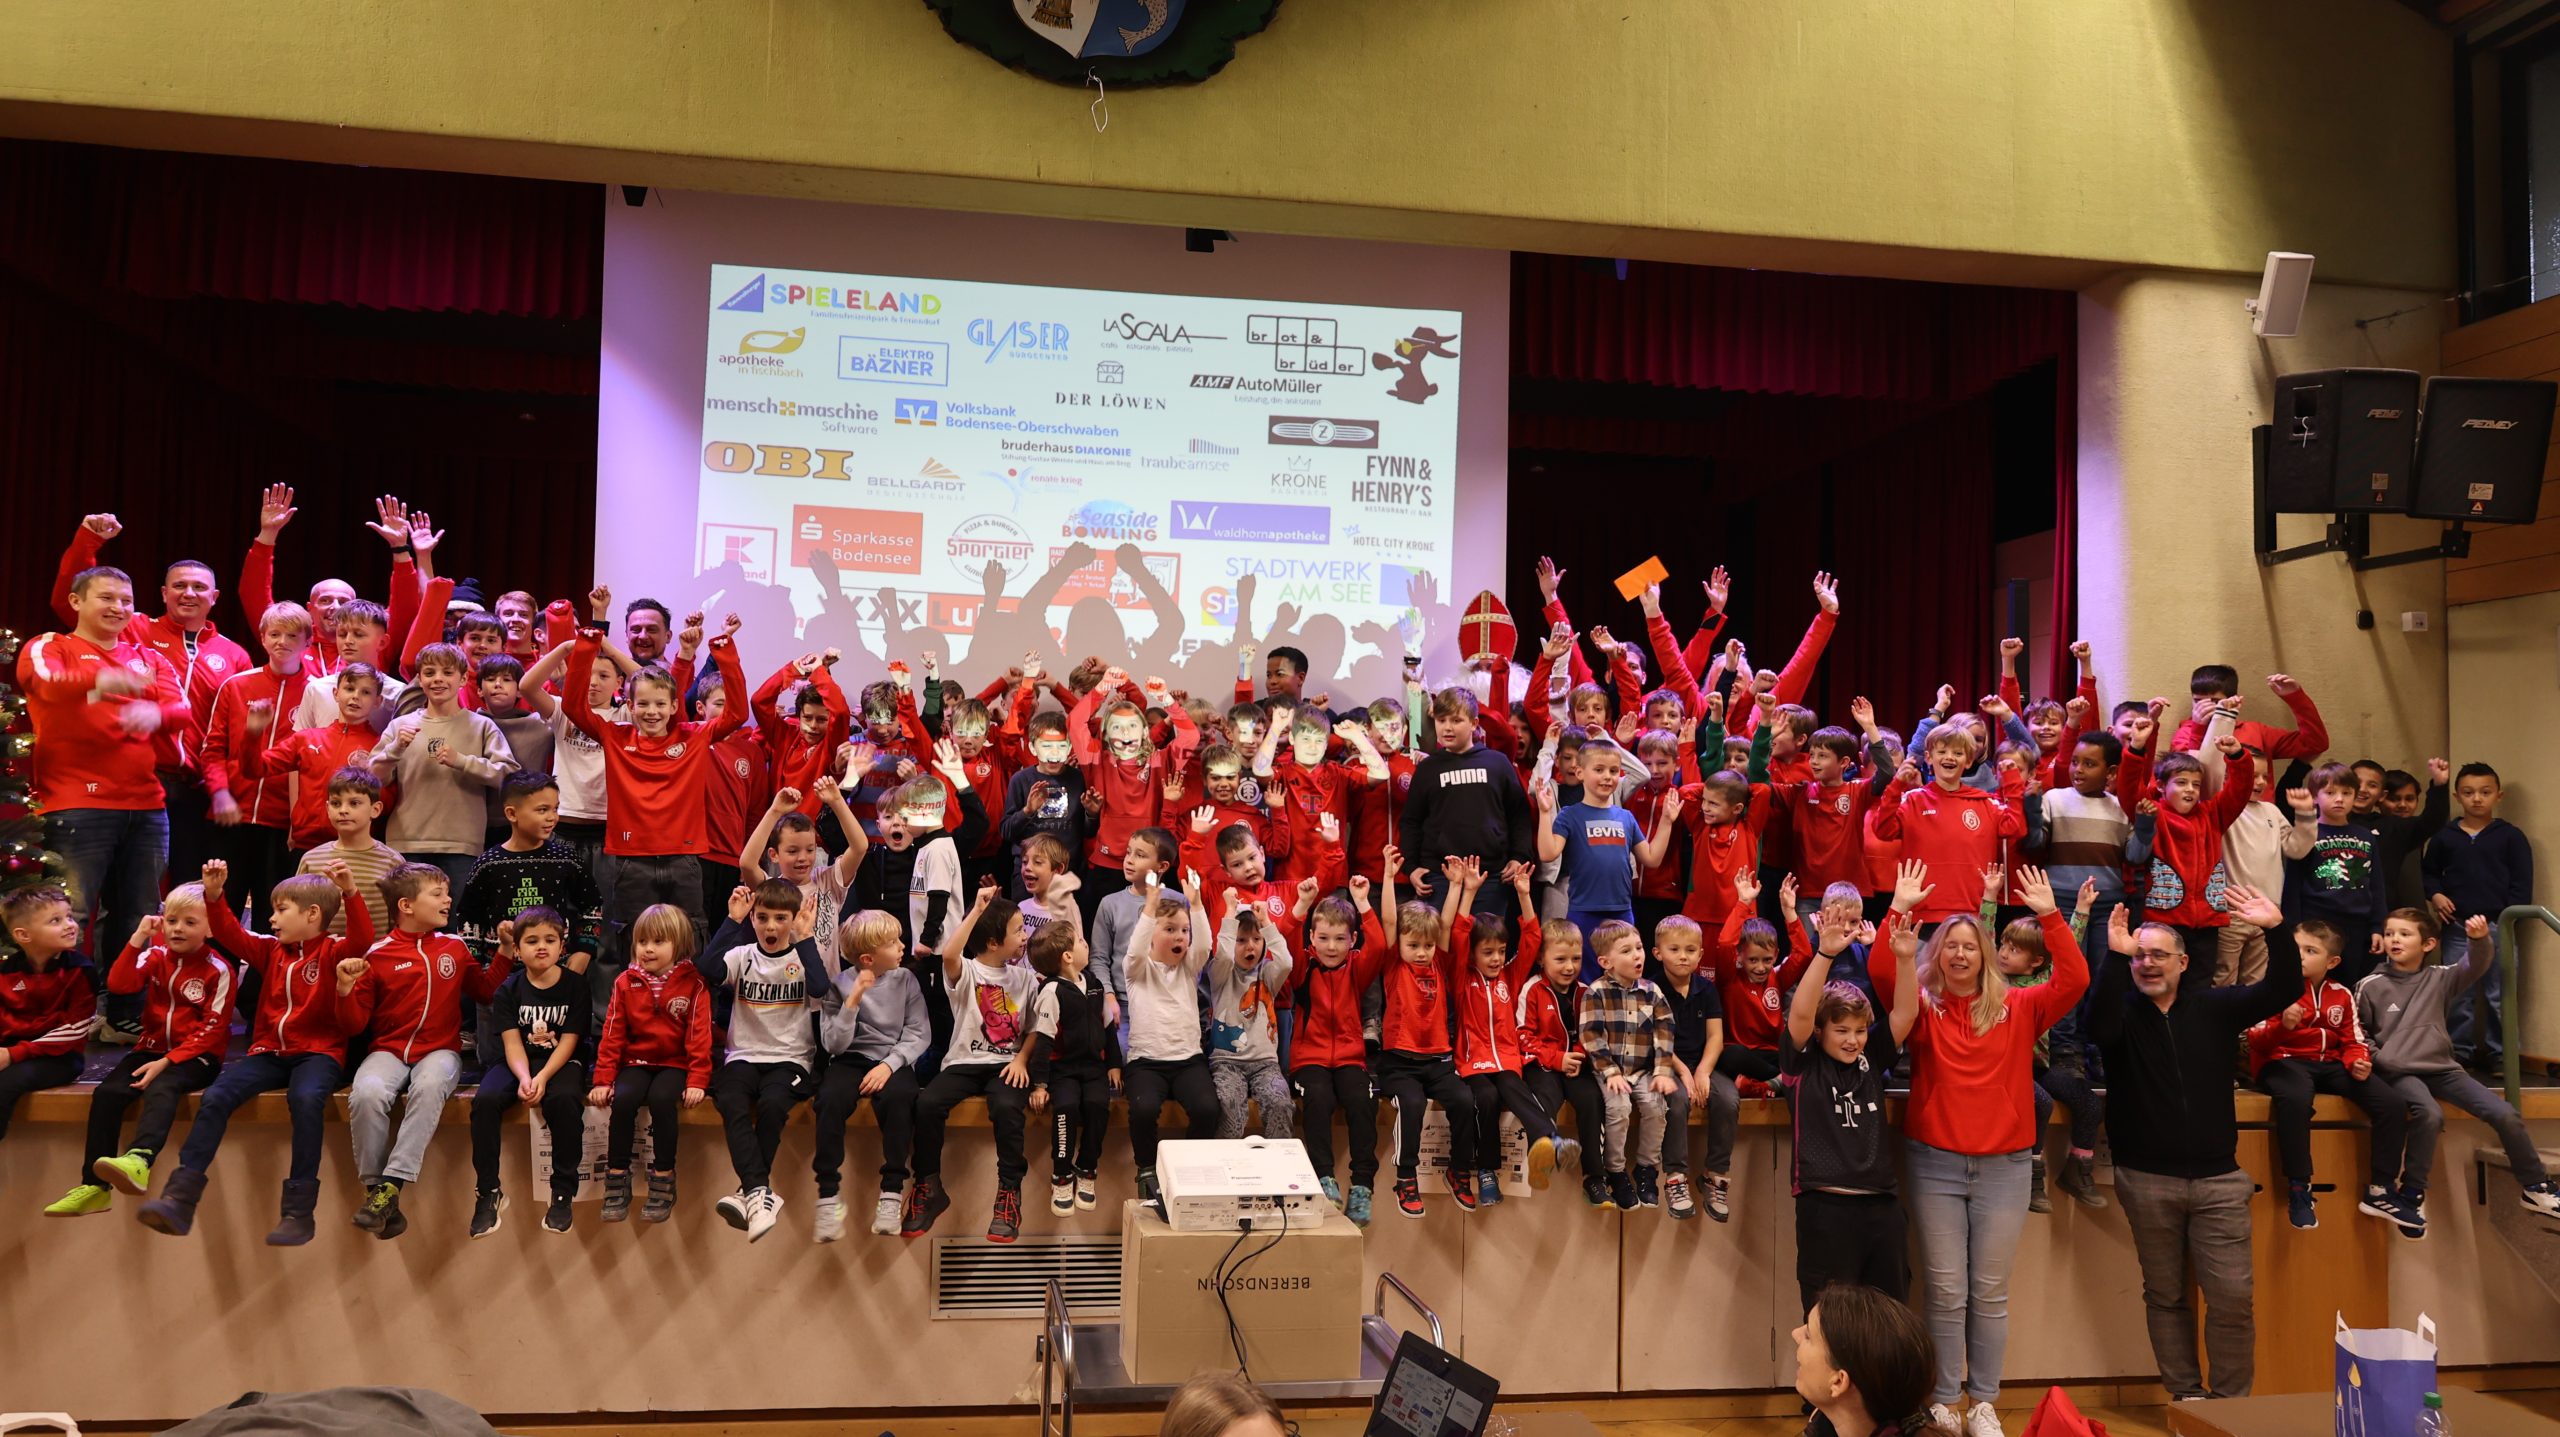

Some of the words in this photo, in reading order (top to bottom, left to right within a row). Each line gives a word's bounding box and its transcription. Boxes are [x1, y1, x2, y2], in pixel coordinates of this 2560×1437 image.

[770, 283, 942, 315] SPIELELAND
[967, 318, 1069, 364] GLASER
[718, 354, 784, 367] apotheke
[879, 347, 934, 360] ELEKTRO
[750, 366, 804, 378] fischbach
[851, 354, 933, 377] BÄZNER
[1193, 376, 1233, 389] AMF
[1235, 376, 1322, 394] AutoMüller
[946, 402, 1016, 417] Volksbank
[1056, 392, 1092, 406] DER
[1101, 393, 1167, 410] LÖWEN
[821, 420, 878, 435] Software
[945, 416, 1119, 437] Bodensee-Oberschwaben
[2461, 419, 2519, 430] PEAVEY
[1001, 439, 1132, 457] bruderhausDIAKONIE
[704, 440, 854, 481] OBI
[1366, 455, 1416, 479] FYNN
[1418, 459, 1432, 481] &
[867, 476, 967, 492] BELLGARDT
[1271, 473, 1327, 489] KRONE
[1077, 508, 1159, 529] Seaside
[832, 529, 914, 547] Sparkasse
[1062, 525, 1158, 541] BOWLING
[1213, 528, 1327, 542] waldhornapotheke
[1353, 536, 1380, 547] HOTEL
[1383, 538, 1403, 549] CITY
[1406, 539, 1435, 552] KRONE
[832, 548, 912, 565] Bodensee
[1225, 556, 1373, 582] STADTWERK
[1278, 583, 1322, 602] AM
[1330, 584, 1373, 603] SEE
[1439, 768, 1488, 788] PUMA
[86, 783, 98, 792] YF
[622, 831, 632, 841] IF
[2314, 837, 2372, 853] ROARSOME
[394, 961, 413, 971] JAKO
[744, 958, 753, 976] 7
[738, 978, 805, 1001] DEUTSCHLAND
[518, 1004, 569, 1027] STAYING
[1057, 1113, 1067, 1158] RUNNING
[1197, 1277, 1311, 1291] BERENDSOHN
